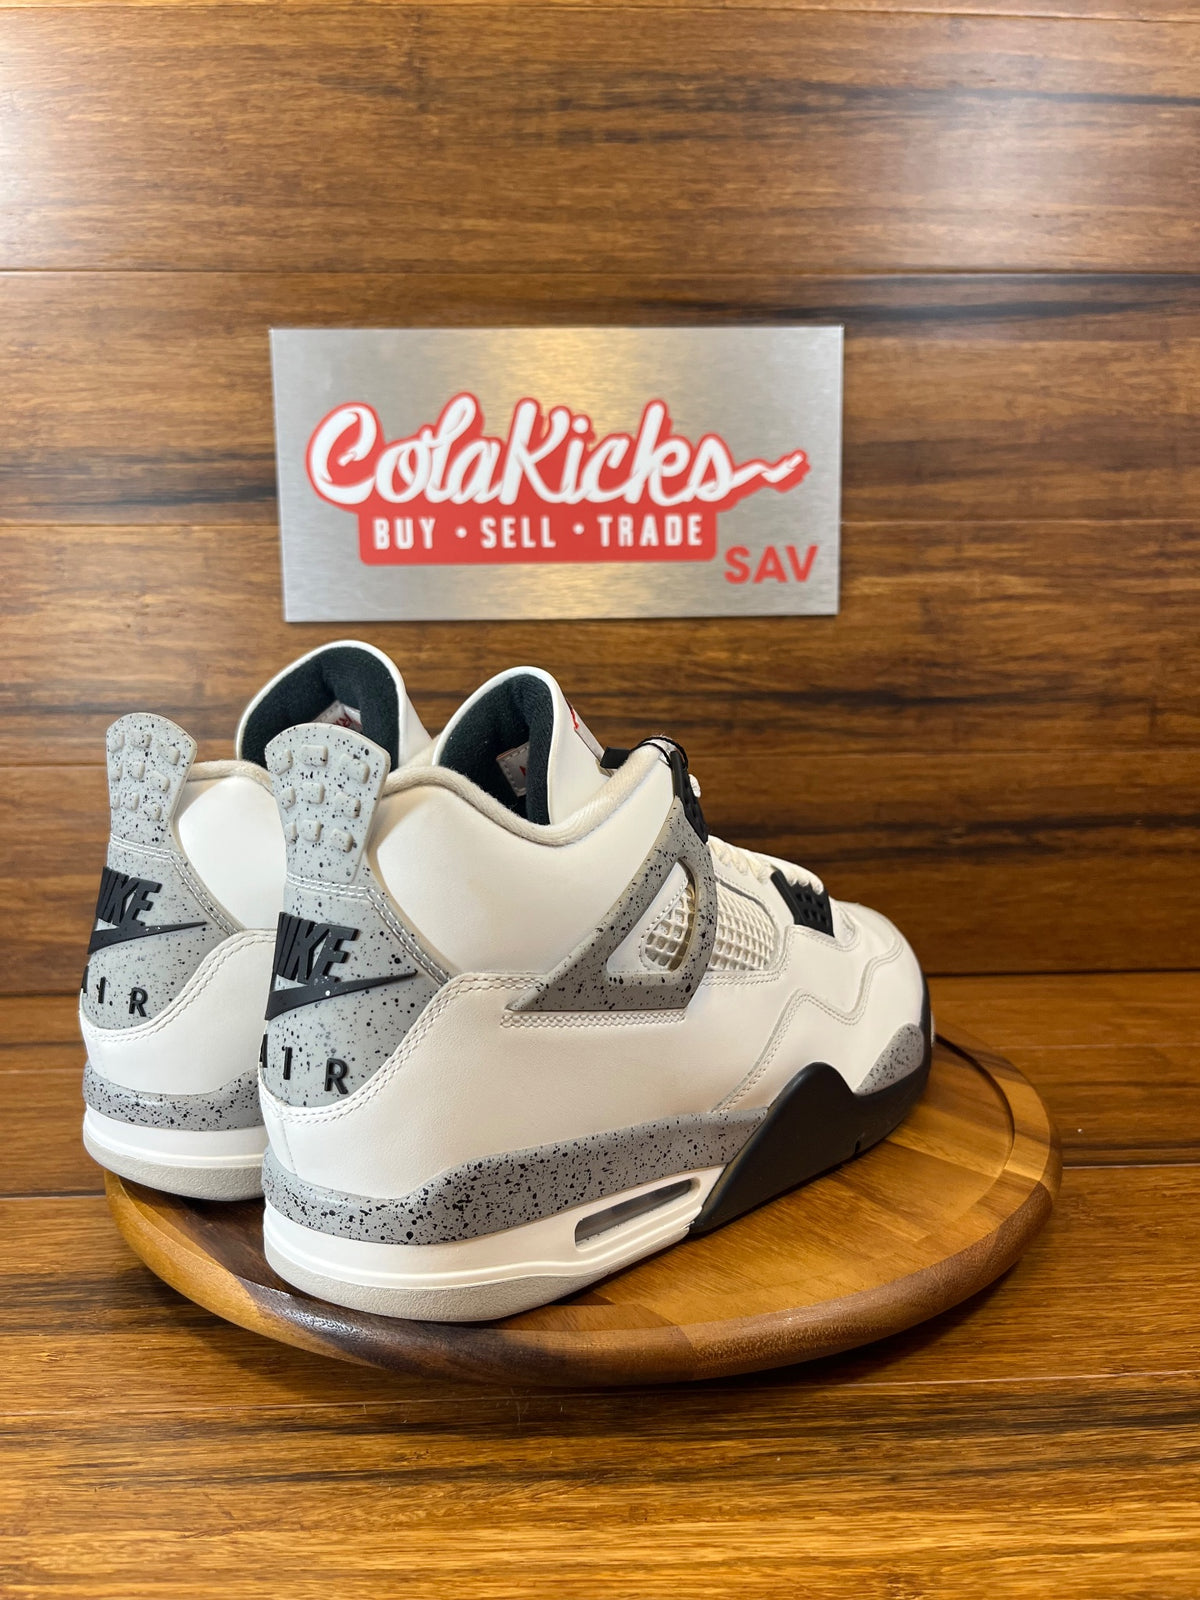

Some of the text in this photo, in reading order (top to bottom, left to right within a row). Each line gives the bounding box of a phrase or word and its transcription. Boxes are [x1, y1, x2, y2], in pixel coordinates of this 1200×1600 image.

[306, 394, 805, 506] ColaKicks
[373, 514, 703, 550] BUY SELL TRADE
[724, 545, 818, 584] SAV
